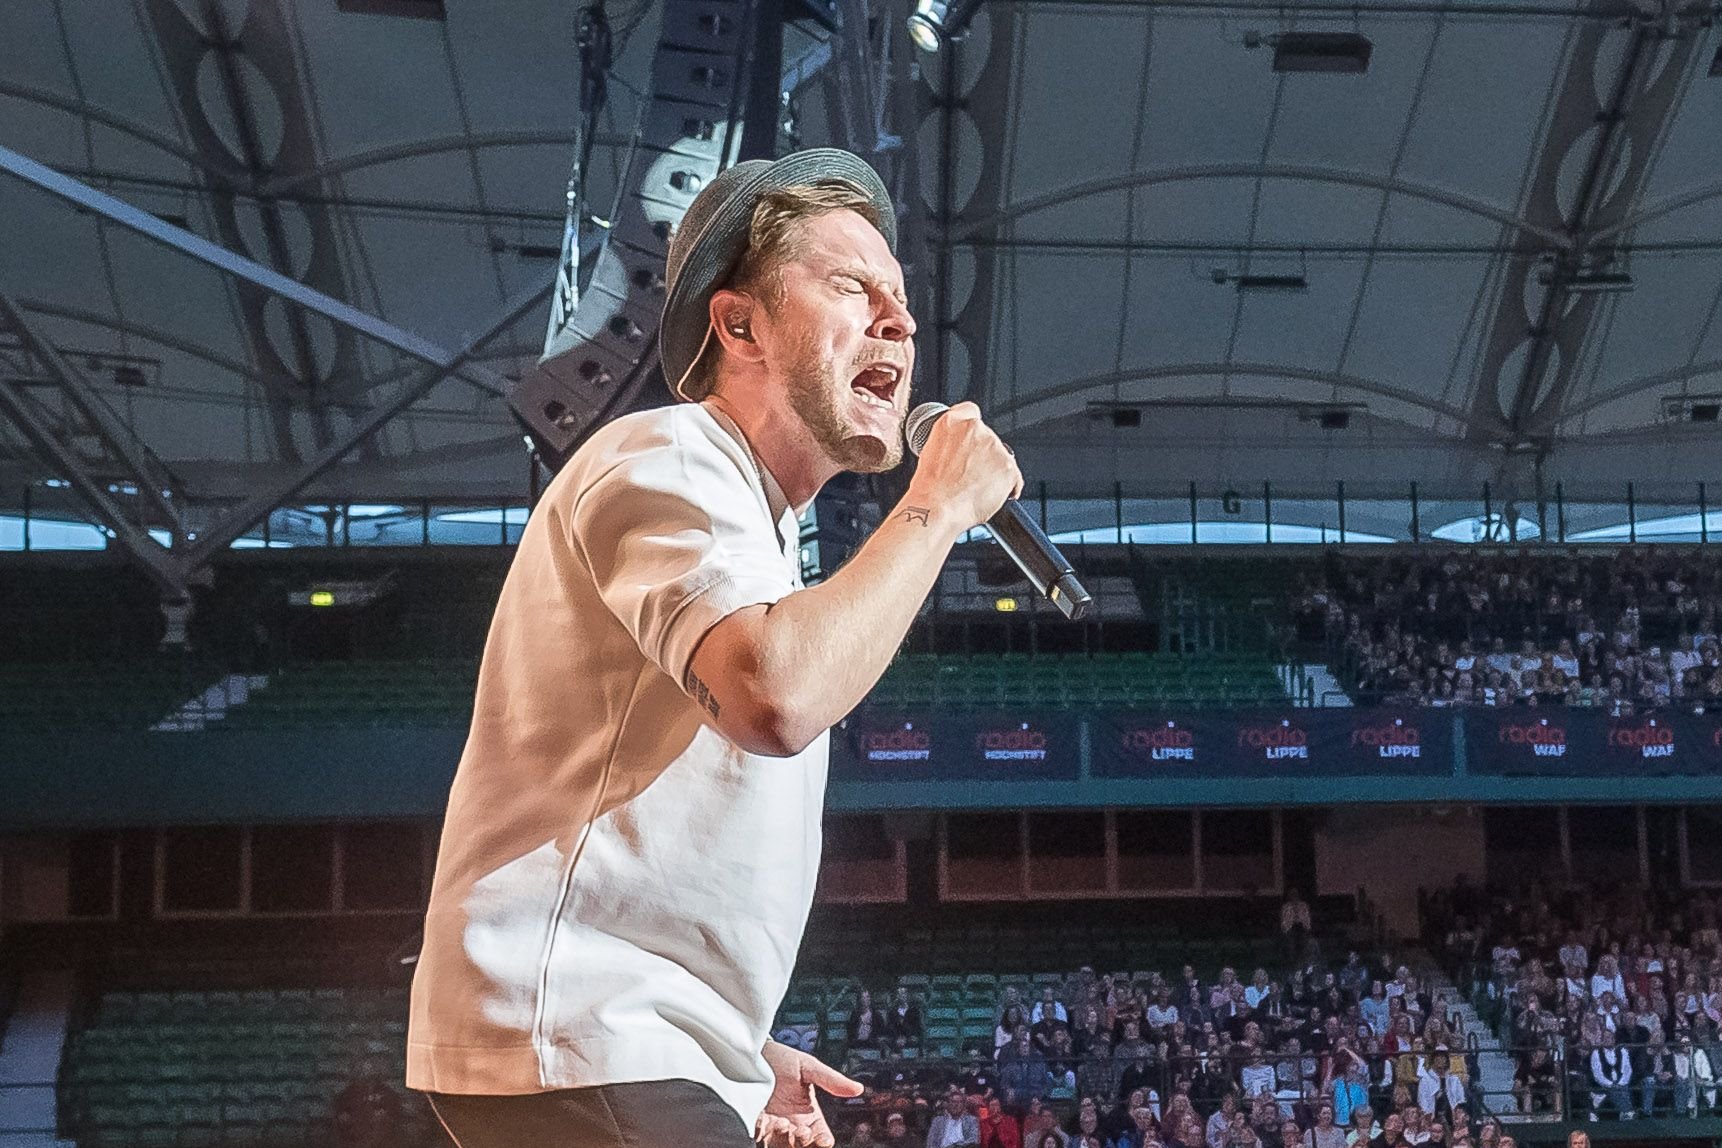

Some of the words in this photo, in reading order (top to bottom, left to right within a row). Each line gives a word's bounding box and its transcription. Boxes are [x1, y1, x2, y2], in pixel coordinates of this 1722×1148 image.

[1223, 489, 1241, 514] G
[1151, 746, 1195, 760] LIPPE
[1266, 745, 1309, 759] LIPPE
[1379, 744, 1421, 758] LIPPE
[1533, 743, 1567, 756] WAF
[1641, 743, 1675, 757] WAF
